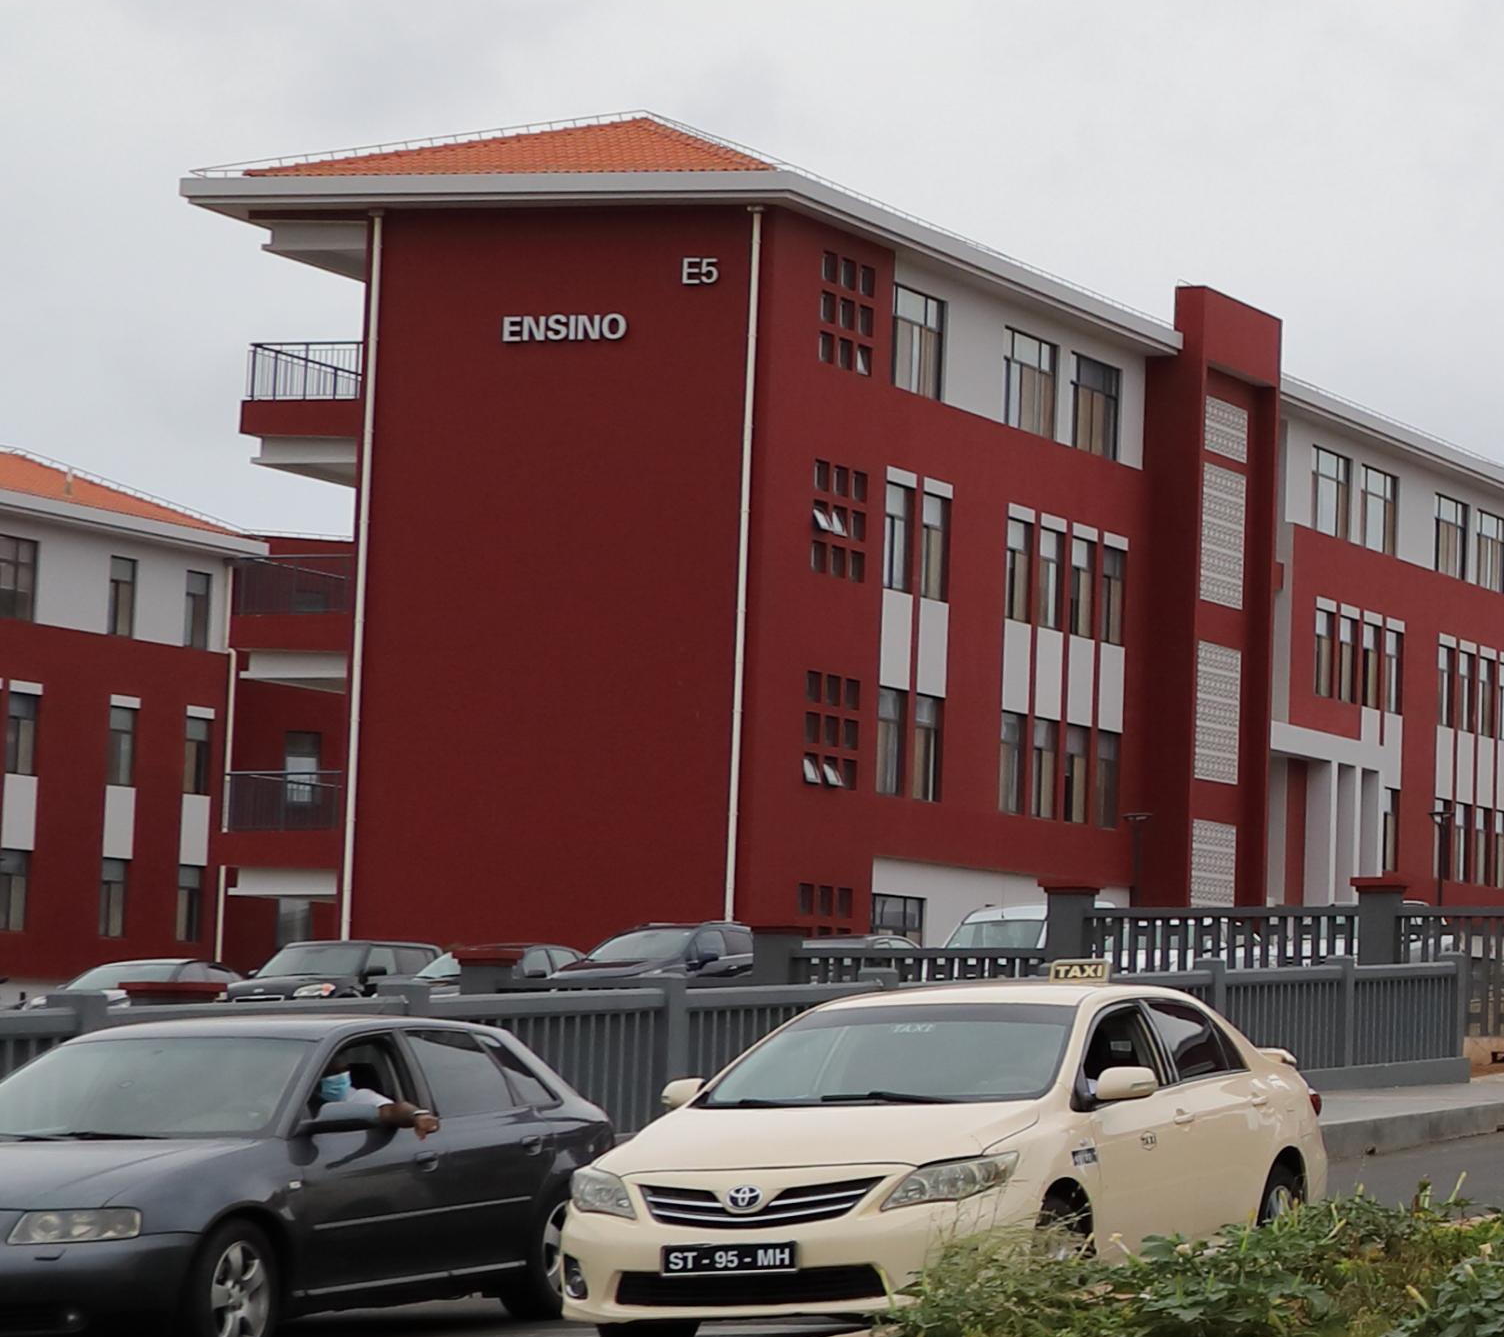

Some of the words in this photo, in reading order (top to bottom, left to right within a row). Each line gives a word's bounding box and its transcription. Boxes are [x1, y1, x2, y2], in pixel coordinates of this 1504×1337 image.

[681, 257, 719, 285] E5
[502, 313, 627, 342] ENSINO
[1055, 965, 1104, 979] TAXI
